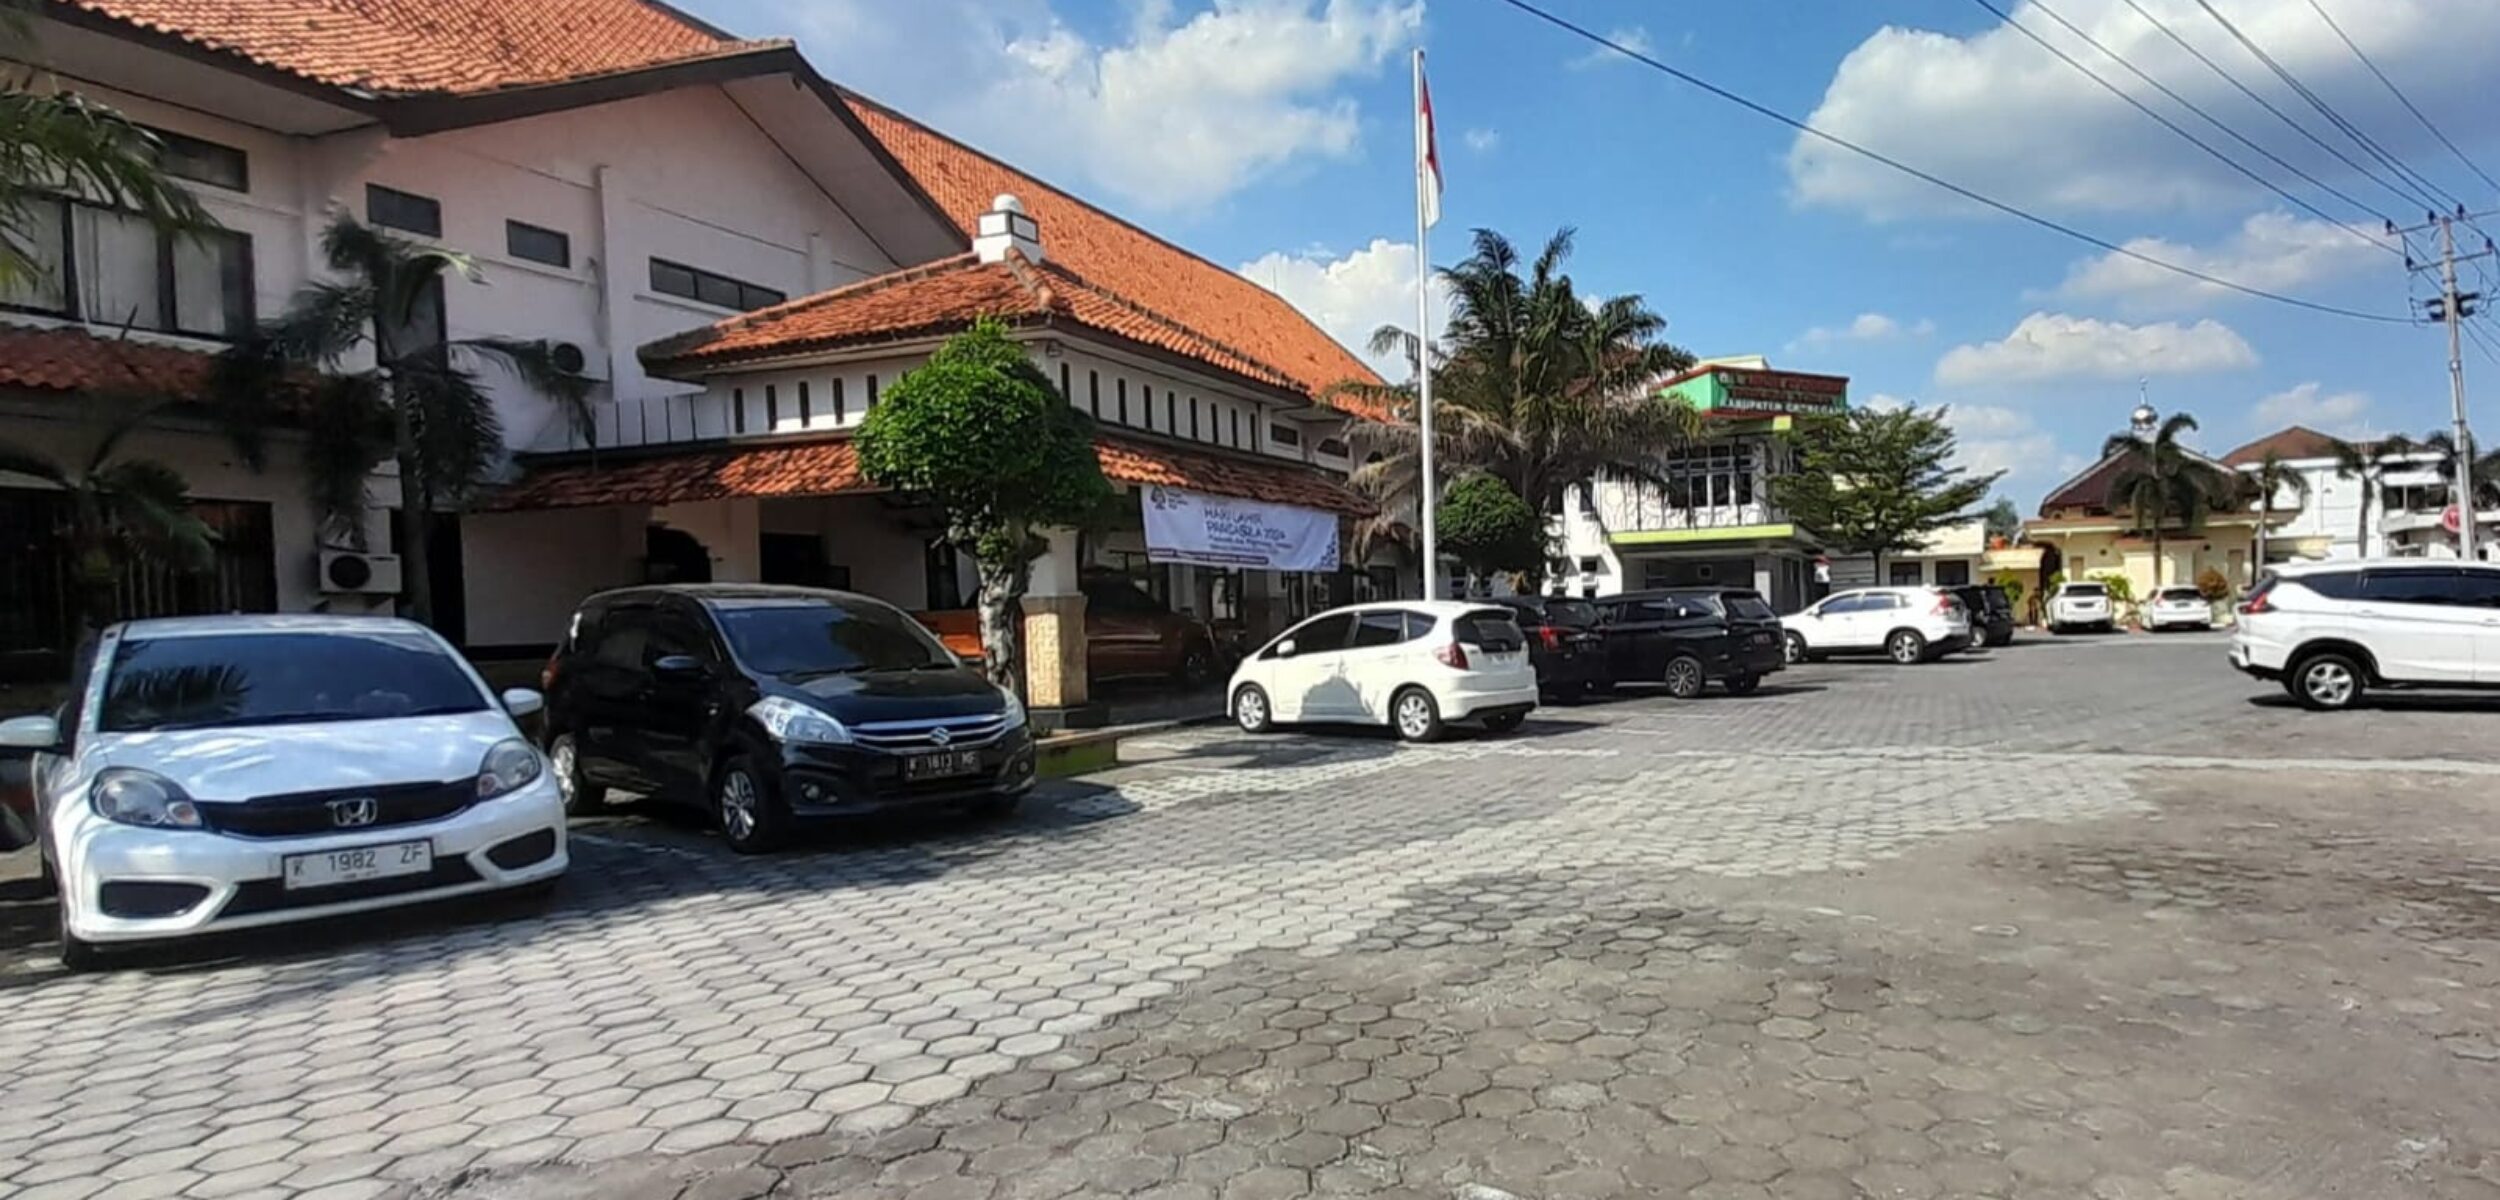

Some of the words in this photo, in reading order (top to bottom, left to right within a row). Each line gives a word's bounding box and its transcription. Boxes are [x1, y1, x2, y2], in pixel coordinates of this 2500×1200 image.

[292, 859, 304, 876] K
[327, 850, 377, 873] 1982
[399, 844, 423, 865] ZF
